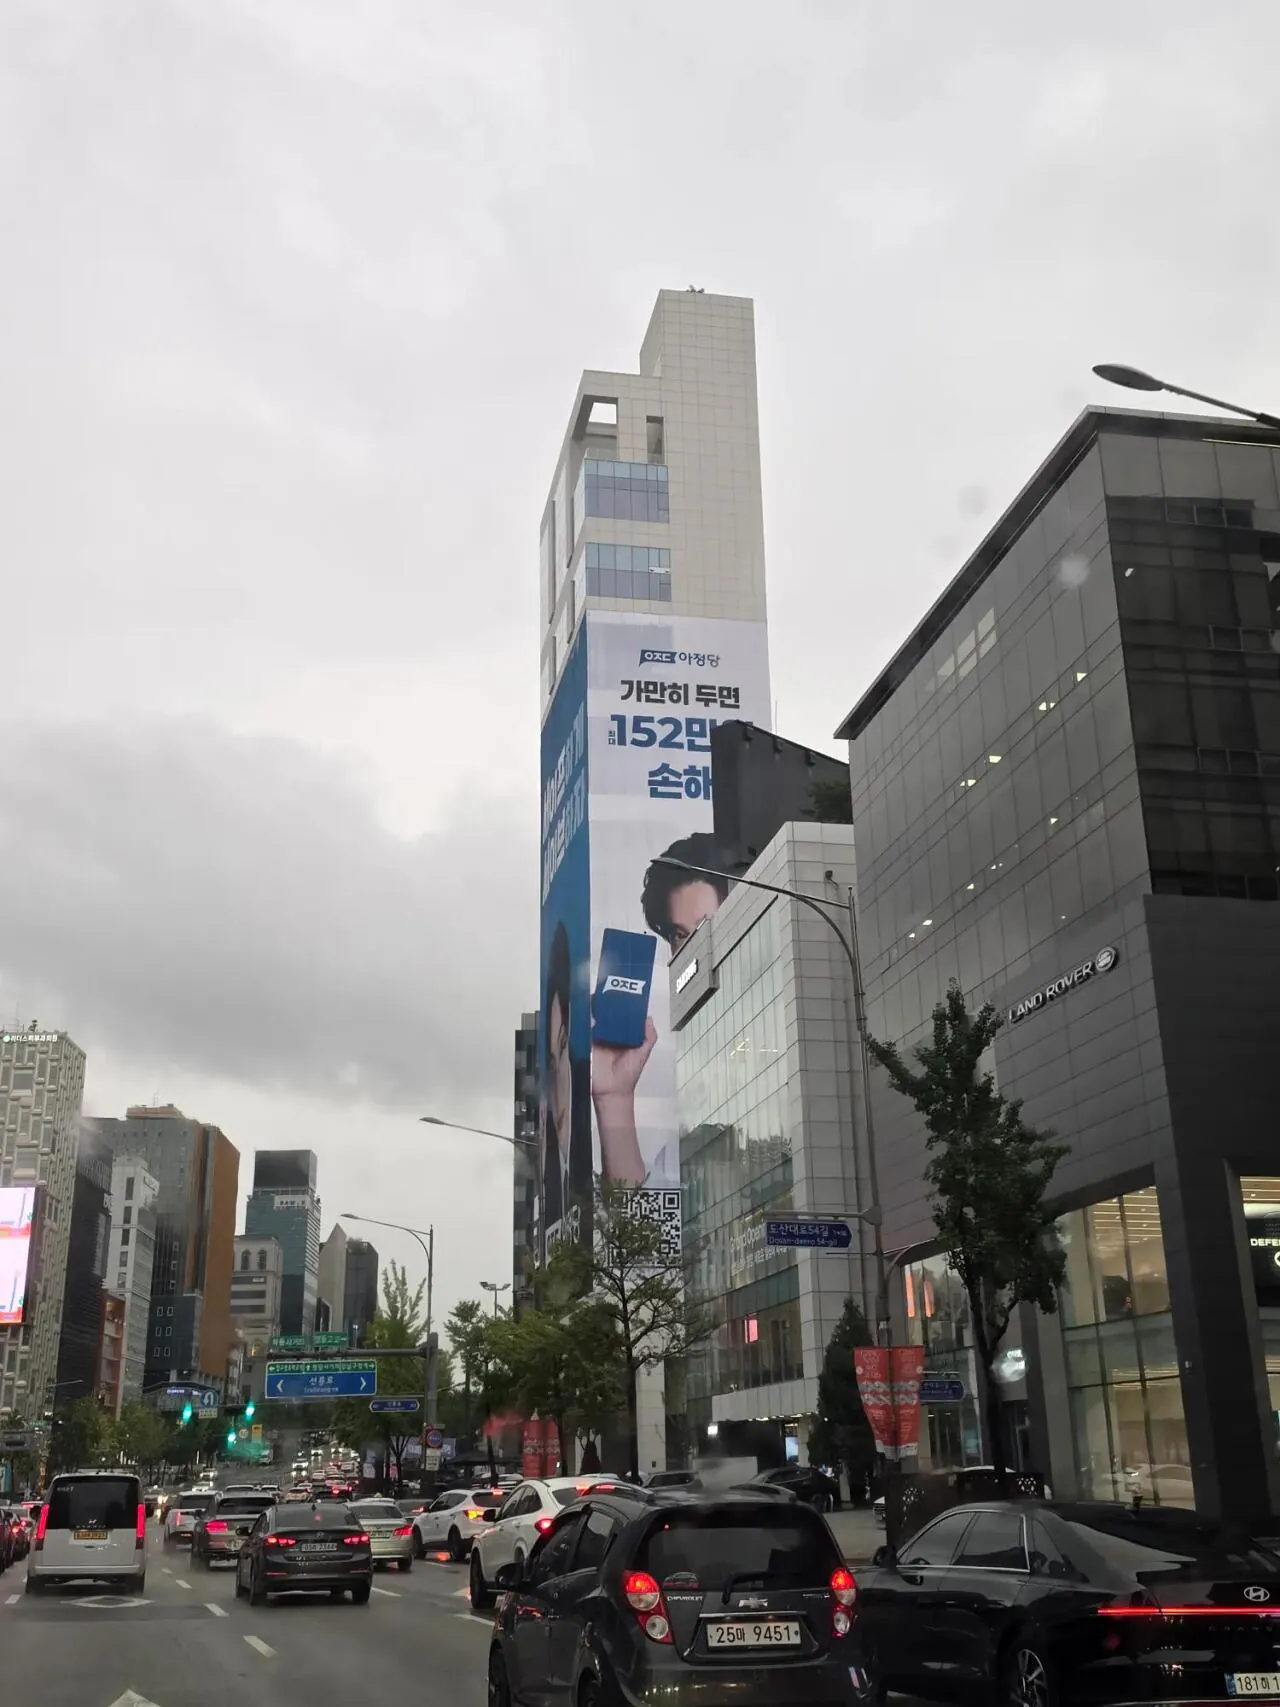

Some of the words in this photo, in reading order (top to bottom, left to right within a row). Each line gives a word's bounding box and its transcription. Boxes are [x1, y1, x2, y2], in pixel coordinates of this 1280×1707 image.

[679, 651, 721, 668] 아정당
[620, 679, 689, 706] 가만히
[695, 684, 740, 709] 두면
[1008, 991, 1043, 1021] LAND
[1046, 961, 1094, 1000] ROVER
[768, 1223, 829, 1237] 도산대로54길
[716, 1626, 746, 1643] 25마
[753, 1625, 791, 1642] 9451
